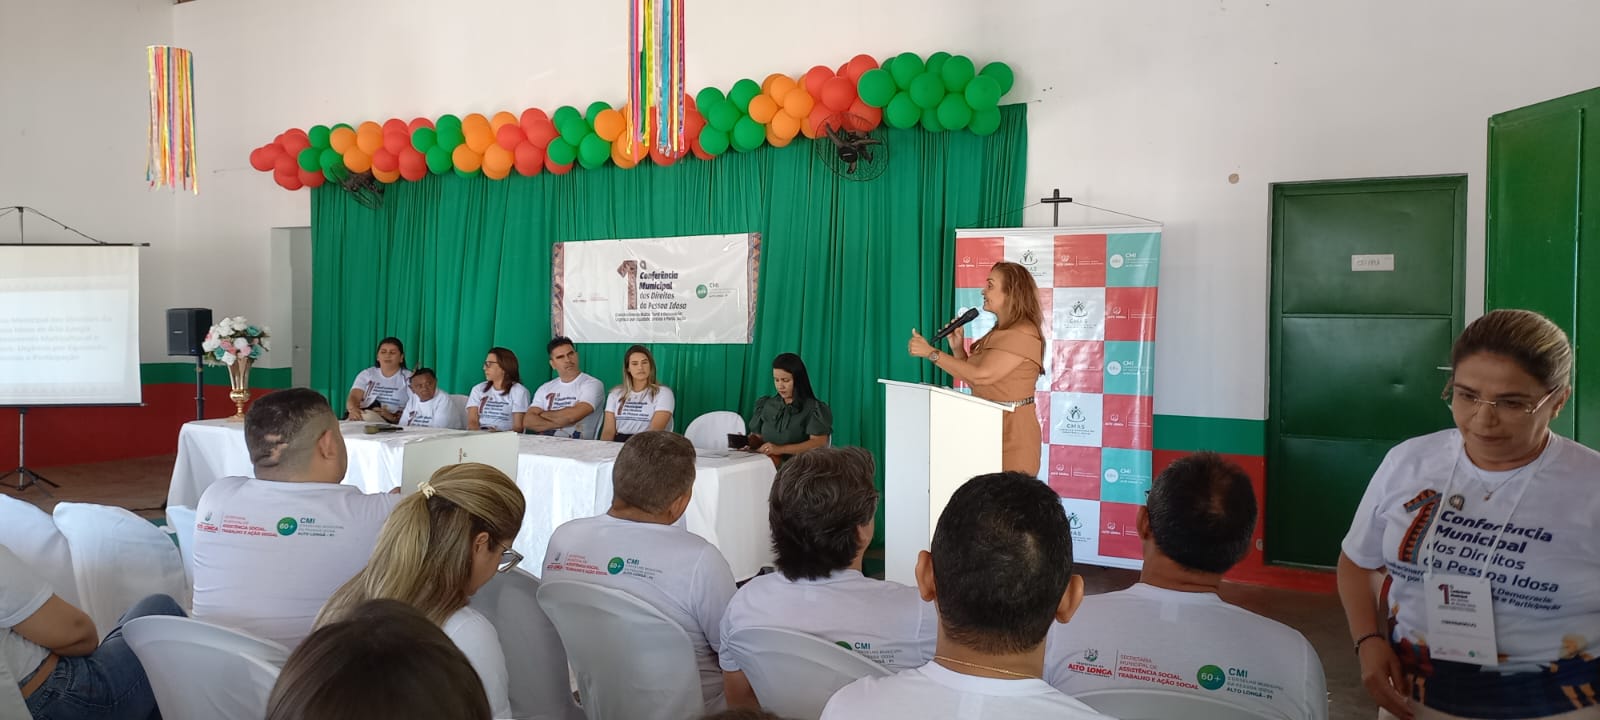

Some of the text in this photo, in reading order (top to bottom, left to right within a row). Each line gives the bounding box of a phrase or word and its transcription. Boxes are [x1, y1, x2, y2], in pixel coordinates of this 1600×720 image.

[639, 281, 673, 291] Municipal
[669, 301, 687, 309] Idosa
[1440, 510, 1553, 543] Conferência
[1434, 524, 1528, 554] Municipal
[1512, 574, 1559, 593] Idosa
[854, 642, 871, 650] CMI
[1068, 663, 1085, 671] ALTO
[1201, 672, 1221, 682] 60+
[1228, 667, 1248, 678] CMI
[1156, 677, 1175, 686] AÇÃO
[1176, 681, 1199, 690] SOCIAL
